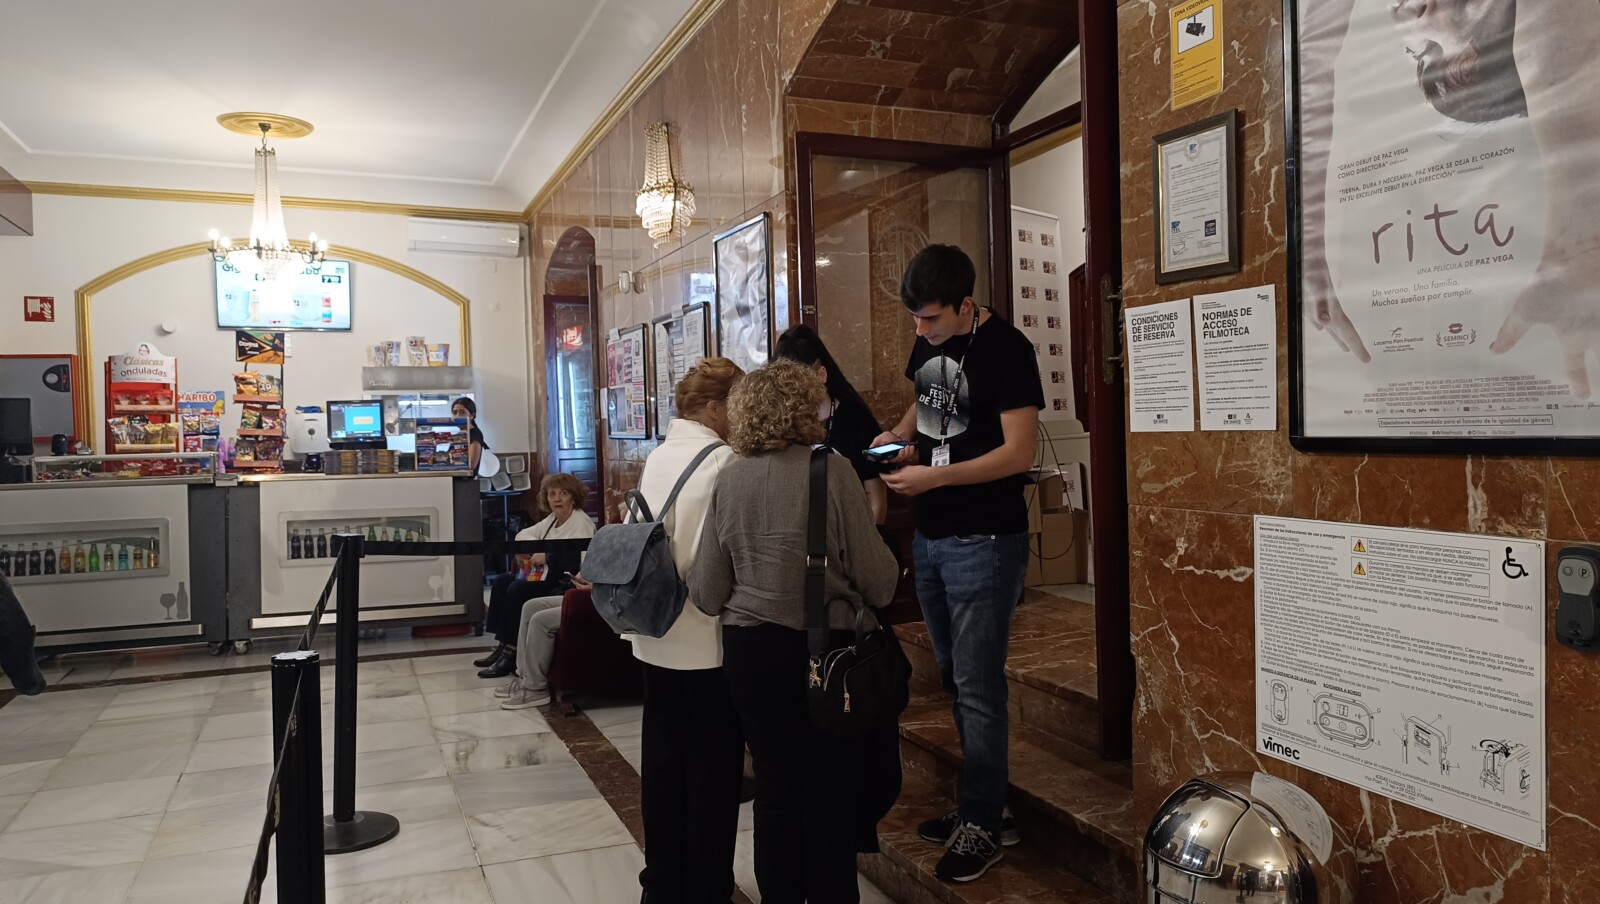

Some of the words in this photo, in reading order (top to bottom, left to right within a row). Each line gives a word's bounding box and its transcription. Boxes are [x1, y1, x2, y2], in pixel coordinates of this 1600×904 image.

[1174, 8, 1185, 17] ZONA
[1355, 157, 1373, 167] DEBUT
[1381, 151, 1392, 160] PAZ
[1393, 147, 1409, 158] VEGA
[1338, 169, 1355, 179] COMO
[1362, 181, 1377, 190] DURA
[1427, 165, 1444, 173] VEGA
[1454, 158, 1470, 167] DEJA
[1479, 147, 1515, 161] CORAZÓN
[1355, 189, 1383, 199] EXCELENTE
[1384, 184, 1401, 193] DEBUT
[1372, 203, 1514, 264] rita
[1417, 267, 1431, 275] UNA
[1433, 262, 1463, 272] PELÍCULA
[1464, 260, 1474, 268] DE
[1475, 257, 1491, 266] PAZ
[1492, 253, 1514, 263] VEGA
[1372, 289, 1382, 297] Un
[1384, 286, 1410, 295] verano.
[1413, 283, 1429, 291] Una
[1431, 278, 1460, 289] familia.
[1372, 298, 1399, 307] Muchos
[1400, 295, 1425, 304] sueños
[1427, 292, 1441, 303] por
[1443, 288, 1474, 300] cumplir.
[1131, 312, 1178, 326] CONDICIONES
[1202, 309, 1238, 321] NORMAS
[1240, 307, 1252, 316] DE
[1132, 326, 1142, 334] DE
[1143, 322, 1175, 333] SERVICIO
[1203, 319, 1237, 330] ACCESO
[1144, 330, 1175, 341] RESERVA
[1203, 326, 1249, 339] FILMOTECA
[124, 356, 165, 366] Clásicas
[120, 367, 168, 378] onduladas
[178, 393, 216, 402] HARIBO
[919, 394, 931, 405] DE
[1498, 417, 1520, 425] igualdad
[1531, 416, 1550, 424] género
[1262, 736, 1300, 760] vimec
